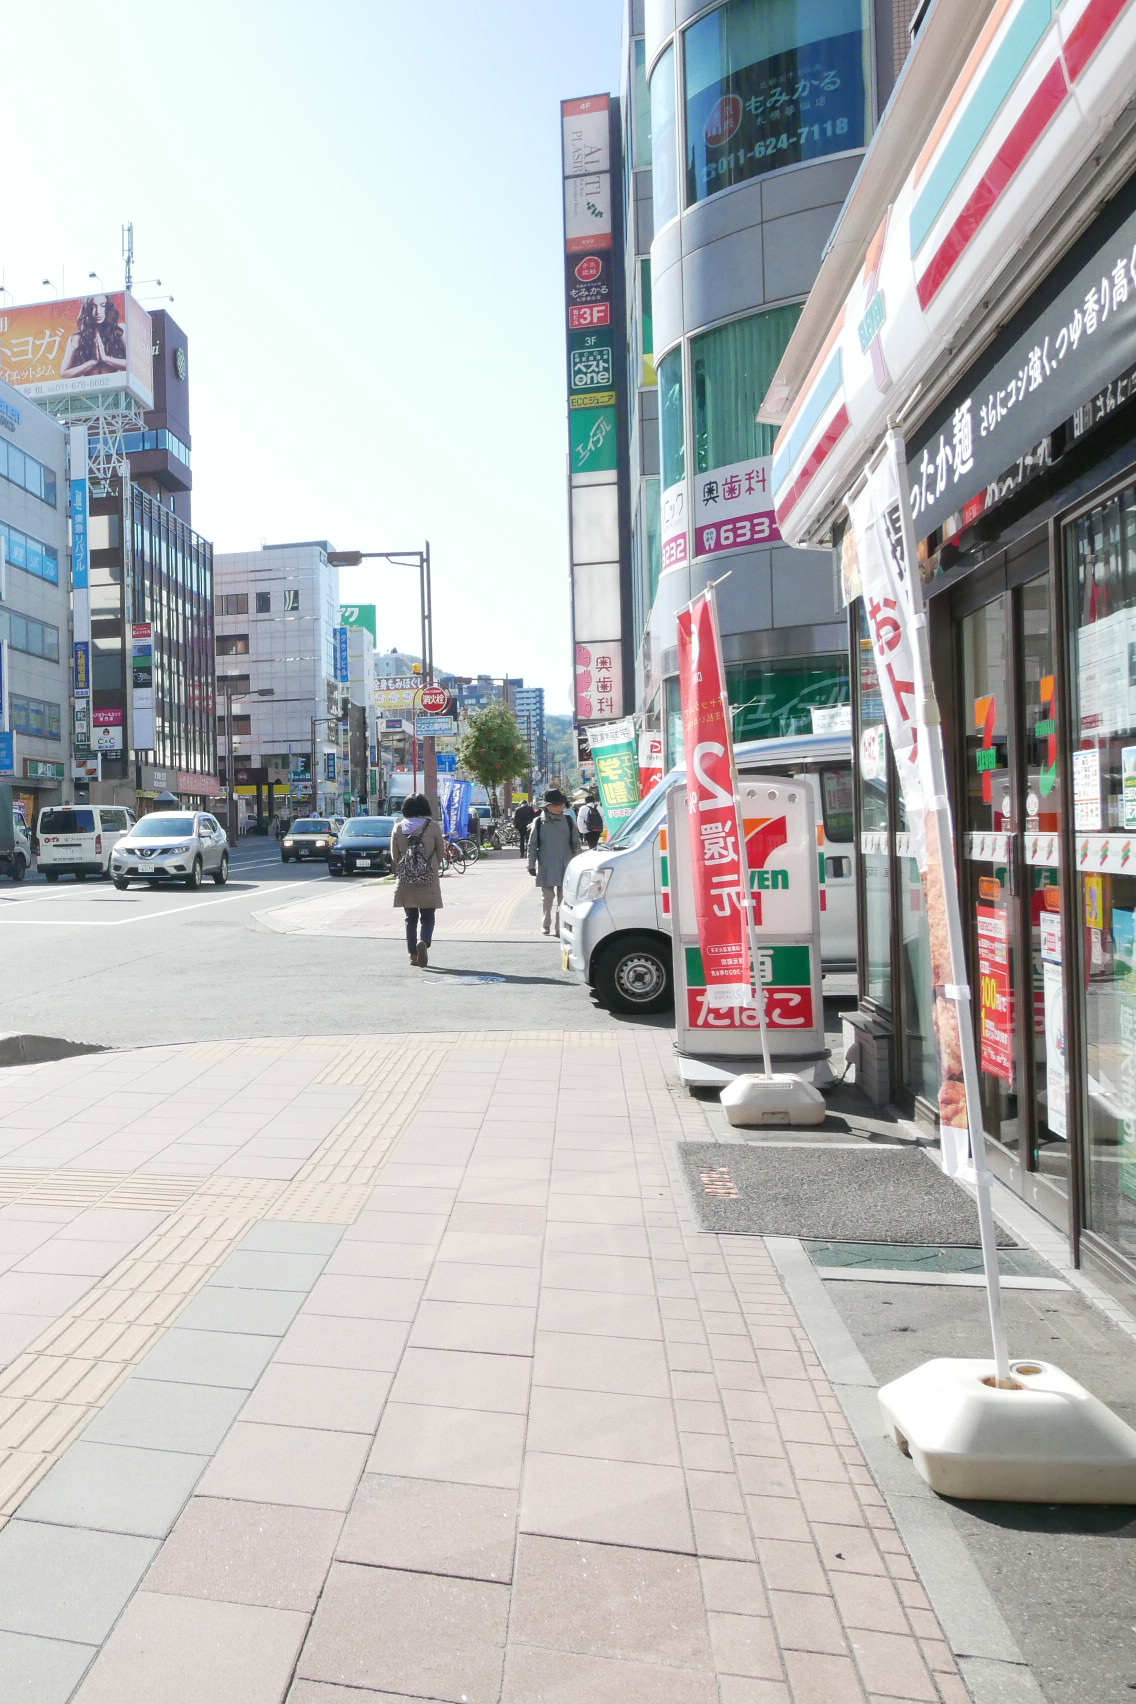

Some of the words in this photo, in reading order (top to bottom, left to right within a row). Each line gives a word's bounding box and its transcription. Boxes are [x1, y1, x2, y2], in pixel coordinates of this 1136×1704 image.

[745, 70, 841, 115] もみかる
[718, 117, 849, 173] 011-624-7118
[570, 285, 608, 297] もみかる
[580, 306, 605, 324] 3F
[585, 336, 596, 346] 3F
[574, 361, 608, 373] ベスト
[55, 377, 110, 392] 011-676-6662
[575, 371, 609, 385] one
[572, 394, 613, 407] ECCジュニア
[575, 416, 611, 466] エイブル
[703, 467, 766, 506] 奥歯科
[374, 678, 422, 690] 全身もみほぐし
[595, 656, 614, 714] 奥歯科
[423, 695, 444, 705] 消火栓
